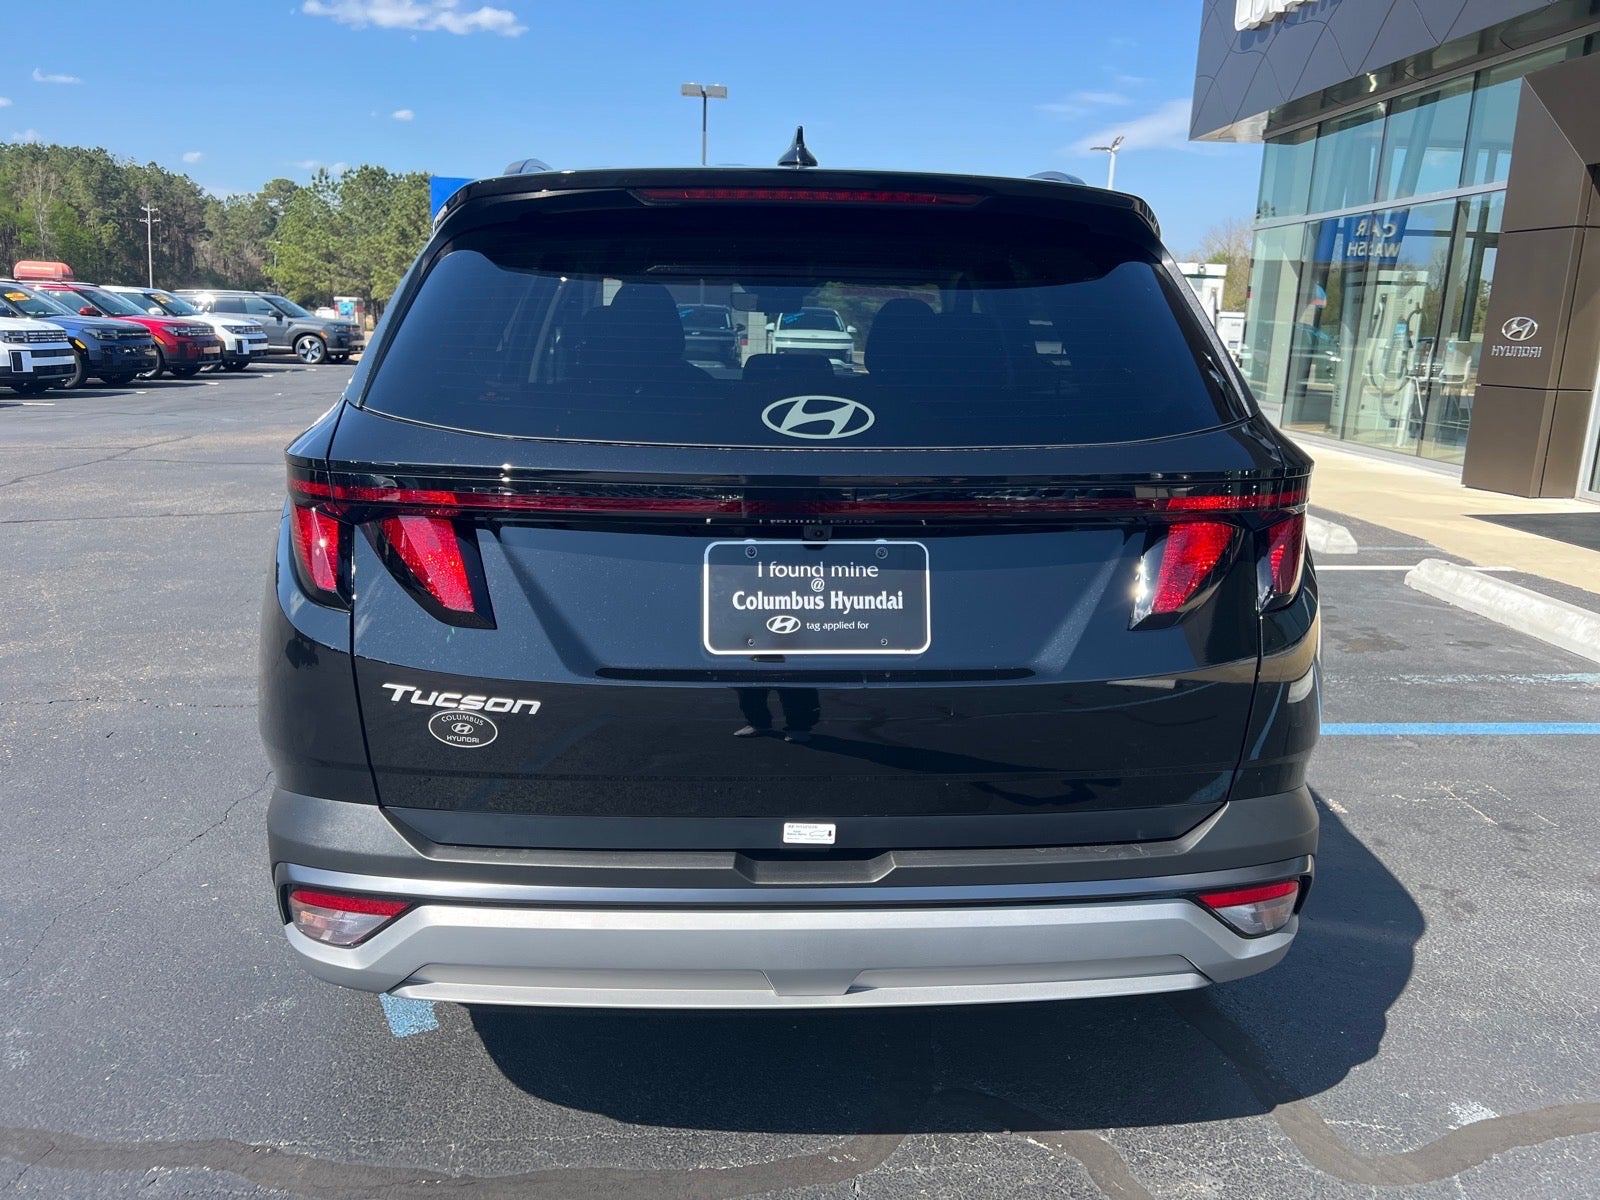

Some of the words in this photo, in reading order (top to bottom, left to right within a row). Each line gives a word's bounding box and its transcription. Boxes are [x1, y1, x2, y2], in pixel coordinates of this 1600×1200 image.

[1491, 345, 1542, 358] HYUNDAI
[769, 561, 824, 578] found
[831, 561, 879, 578] mine
[810, 577, 825, 592] @
[732, 590, 825, 610] Columbus
[830, 590, 904, 614] Hyundai
[806, 620, 821, 631] tag
[822, 620, 855, 630] applied
[857, 620, 869, 630] for
[441, 714, 484, 727] COLUMBUS
[446, 735, 480, 744] HYUNDAI
